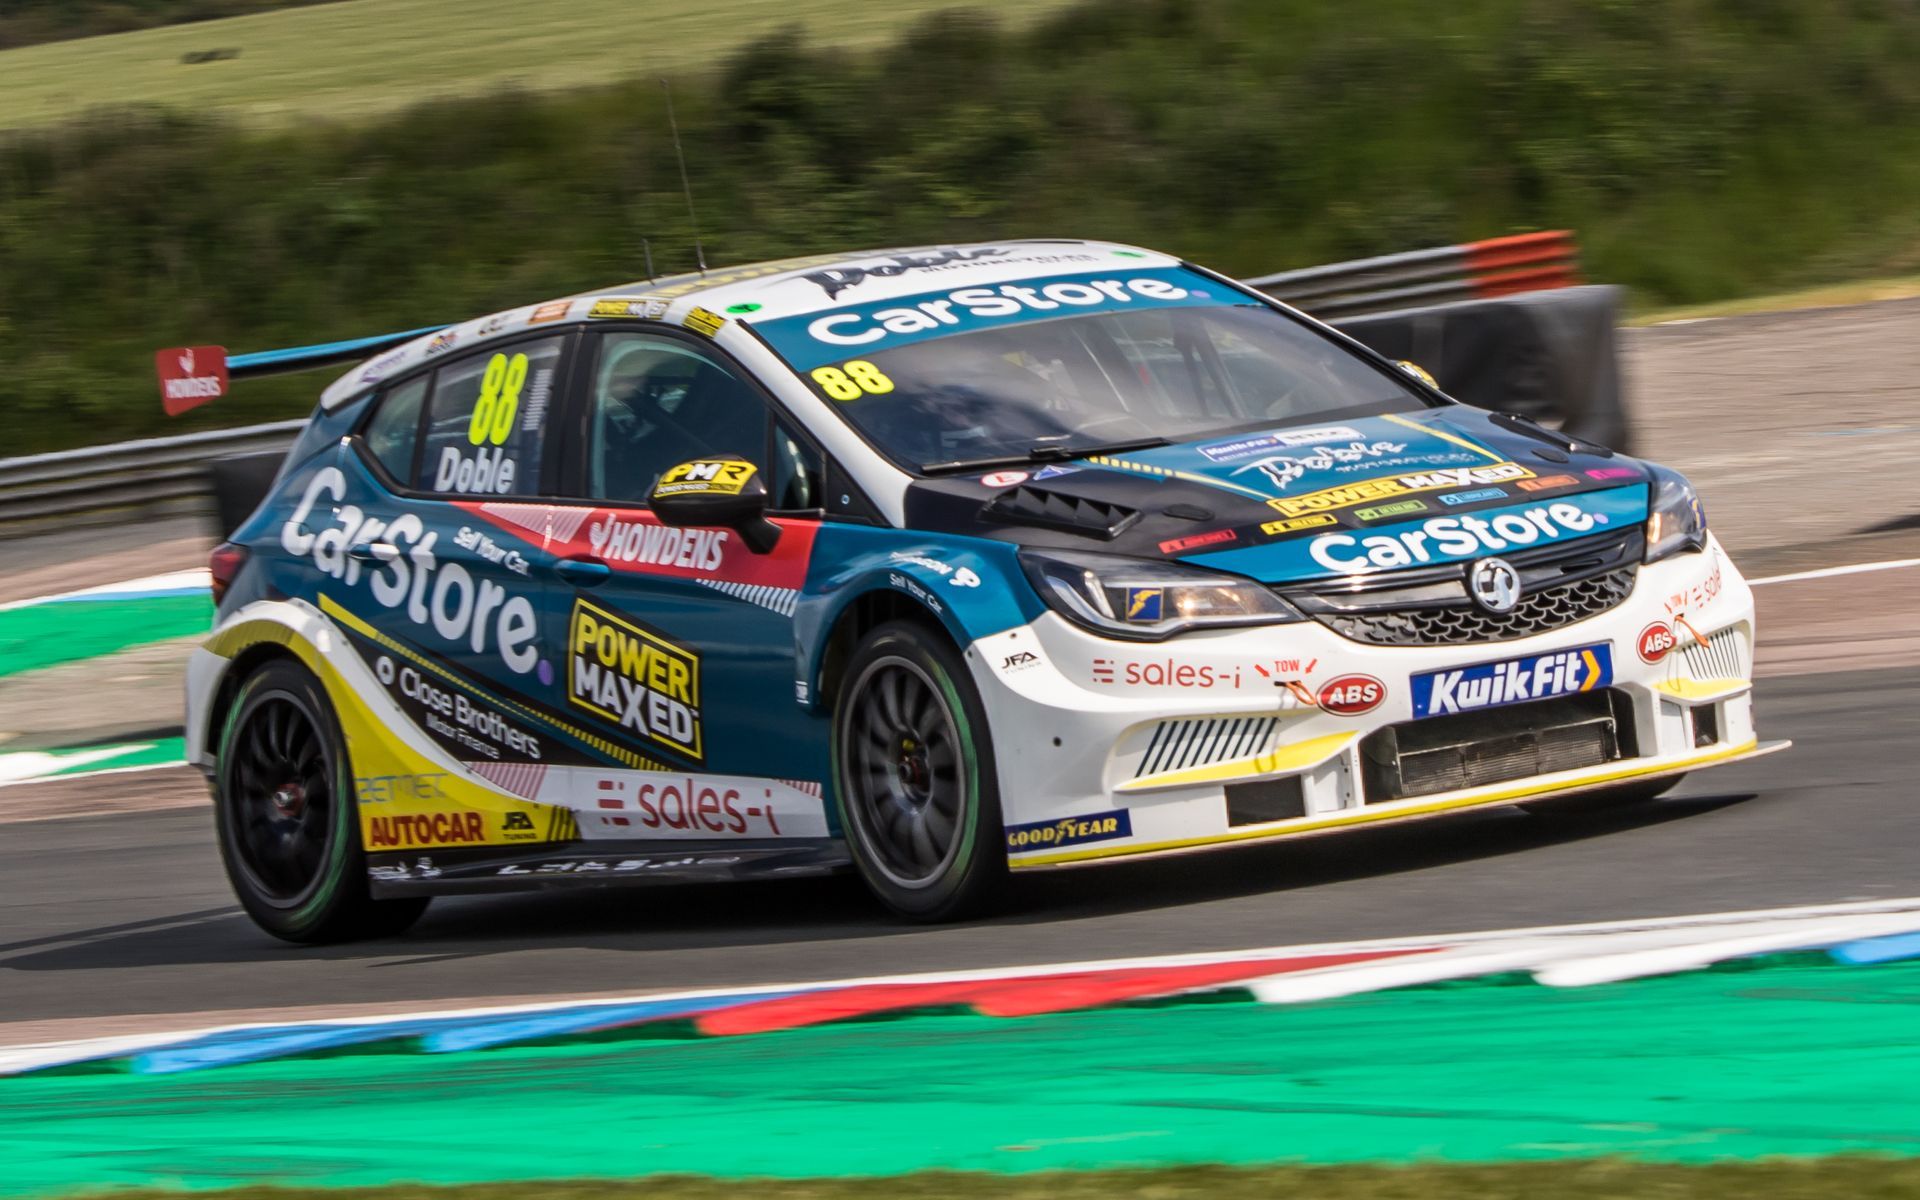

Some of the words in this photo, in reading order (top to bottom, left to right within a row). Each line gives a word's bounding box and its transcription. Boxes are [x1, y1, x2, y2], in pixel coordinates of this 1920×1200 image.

[468, 352, 529, 446] 88
[811, 360, 895, 401] 88
[433, 446, 515, 494] Doble
[662, 462, 748, 483] PMR
[1278, 480, 1407, 513] POWER
[1399, 465, 1525, 489] MAXED
[453, 526, 483, 551] Sell
[475, 536, 507, 565] Your
[503, 550, 530, 576] Car
[603, 522, 729, 571] HOWDENS
[576, 612, 691, 704] POWER
[1002, 651, 1039, 670] JFA
[1274, 659, 1300, 673] TOW
[1644, 631, 1673, 655] ABS
[1125, 658, 1241, 689] sales-i
[1327, 682, 1379, 706] ABS
[400, 667, 453, 716] Close
[454, 693, 542, 759] Brothers
[575, 655, 694, 744] MAXED
[369, 811, 485, 847] AUTOCAR
[637, 778, 781, 834] sales-i
